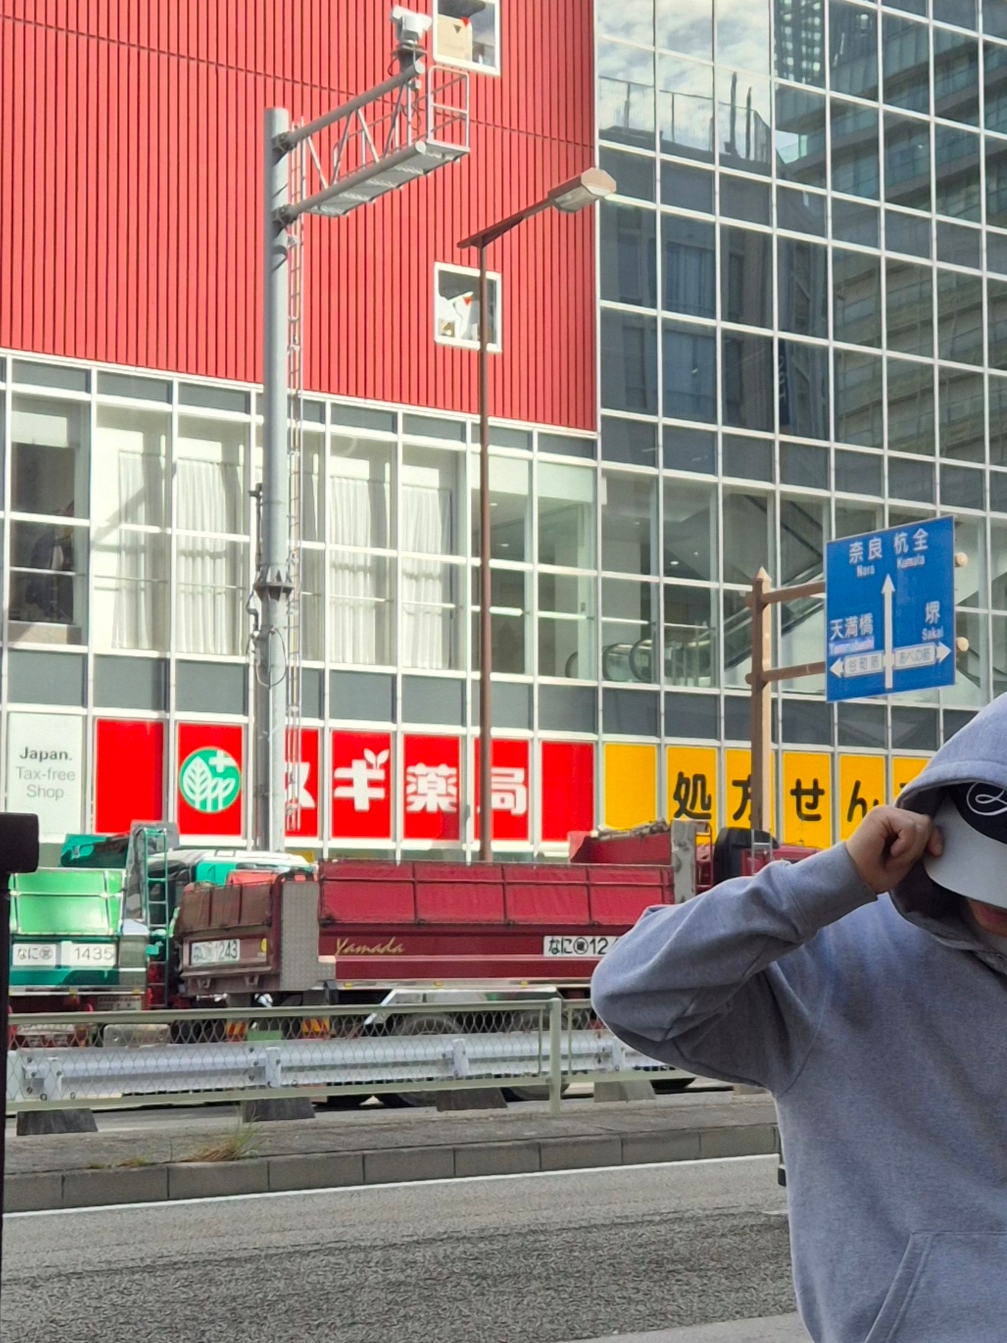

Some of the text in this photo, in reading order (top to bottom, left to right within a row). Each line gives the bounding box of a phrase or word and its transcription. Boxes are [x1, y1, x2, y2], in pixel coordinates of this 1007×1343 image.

[849, 528, 929, 564] 奈良 杭全
[829, 613, 874, 641] 天満橋
[16, 766, 76, 782] Tax-free
[26, 783, 65, 801] Shop
[74, 946, 115, 961] 1435
[335, 936, 406, 956] Yamada
